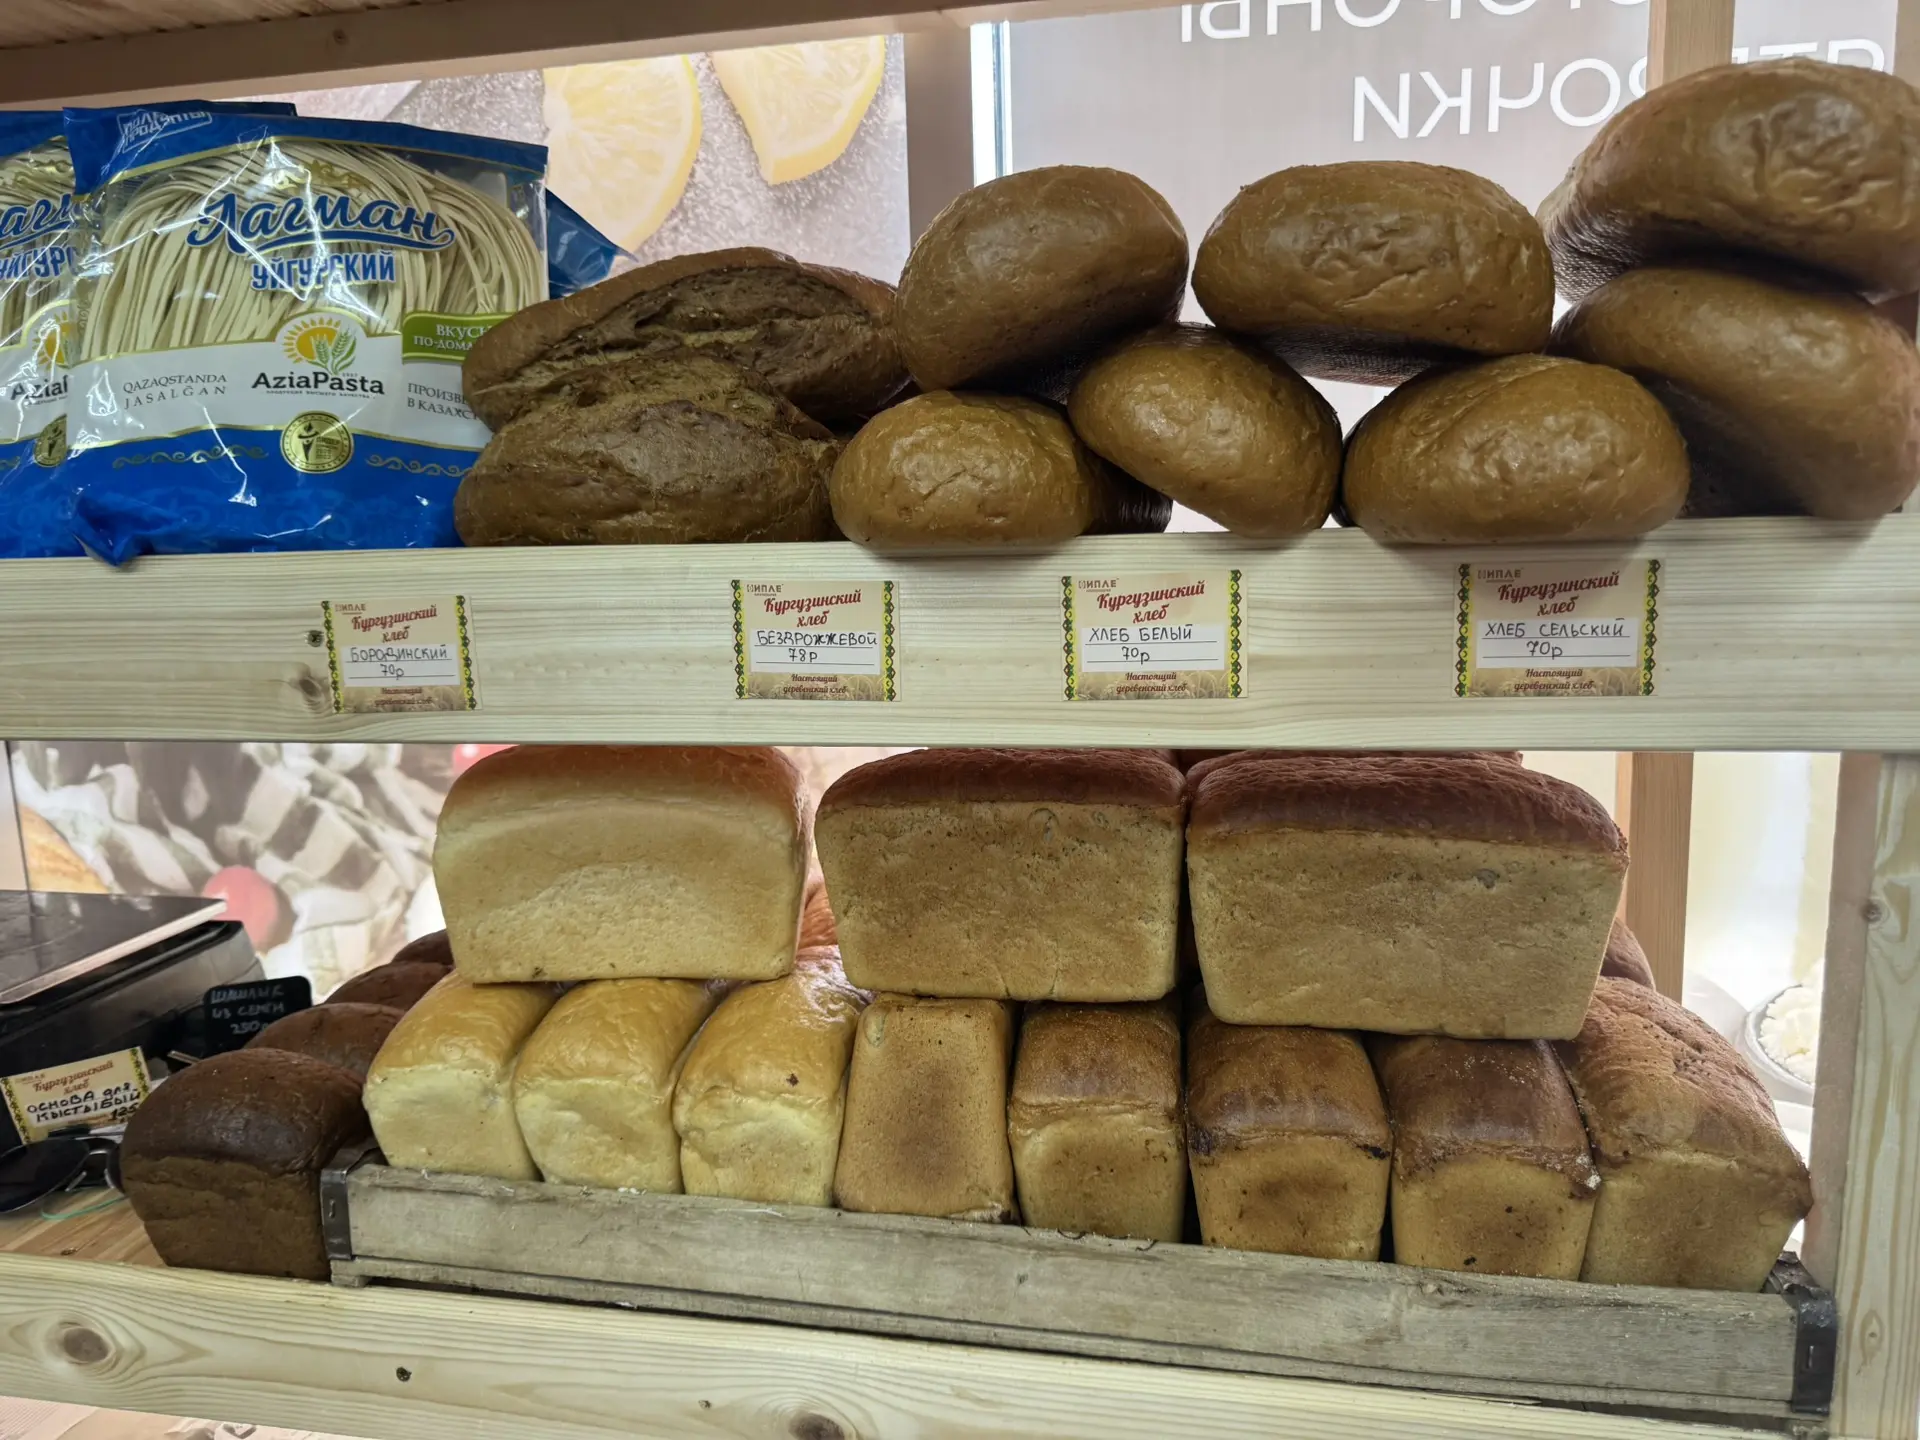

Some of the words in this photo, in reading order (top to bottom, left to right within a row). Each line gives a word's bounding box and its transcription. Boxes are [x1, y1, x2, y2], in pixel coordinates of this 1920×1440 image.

[185, 193, 455, 255] Лагман
[251, 250, 396, 290] УЙГУРСКИЙ
[123, 374, 228, 394] QAZAQSTANDA
[251, 371, 385, 395] AziaPasta
[408, 383, 466, 405] ПРОИЗВ
[418, 400, 478, 420] КАЗАХС
[1097, 580, 1206, 612] Кургузинский
[1497, 571, 1620, 603] Кургузинский
[764, 589, 862, 615] Кургузинский
[1537, 595, 1580, 617] хлеб
[351, 604, 438, 632] Кургузинский
[796, 610, 830, 628] хлеб
[1133, 604, 1169, 624] хлеб
[382, 626, 410, 643] хлеб
[1089, 627, 1130, 642] ХЛЕБ
[1139, 624, 1193, 642] БЕЛЫЙ
[1485, 622, 1525, 638] ХЛЕБ
[1539, 618, 1625, 637] СЕЛЬСКИЙ
[350, 644, 447, 662] БОРОДИНСКИЙ
[1125, 672, 1177, 681] Настоящий
[1525, 669, 1583, 679] Настоящий
